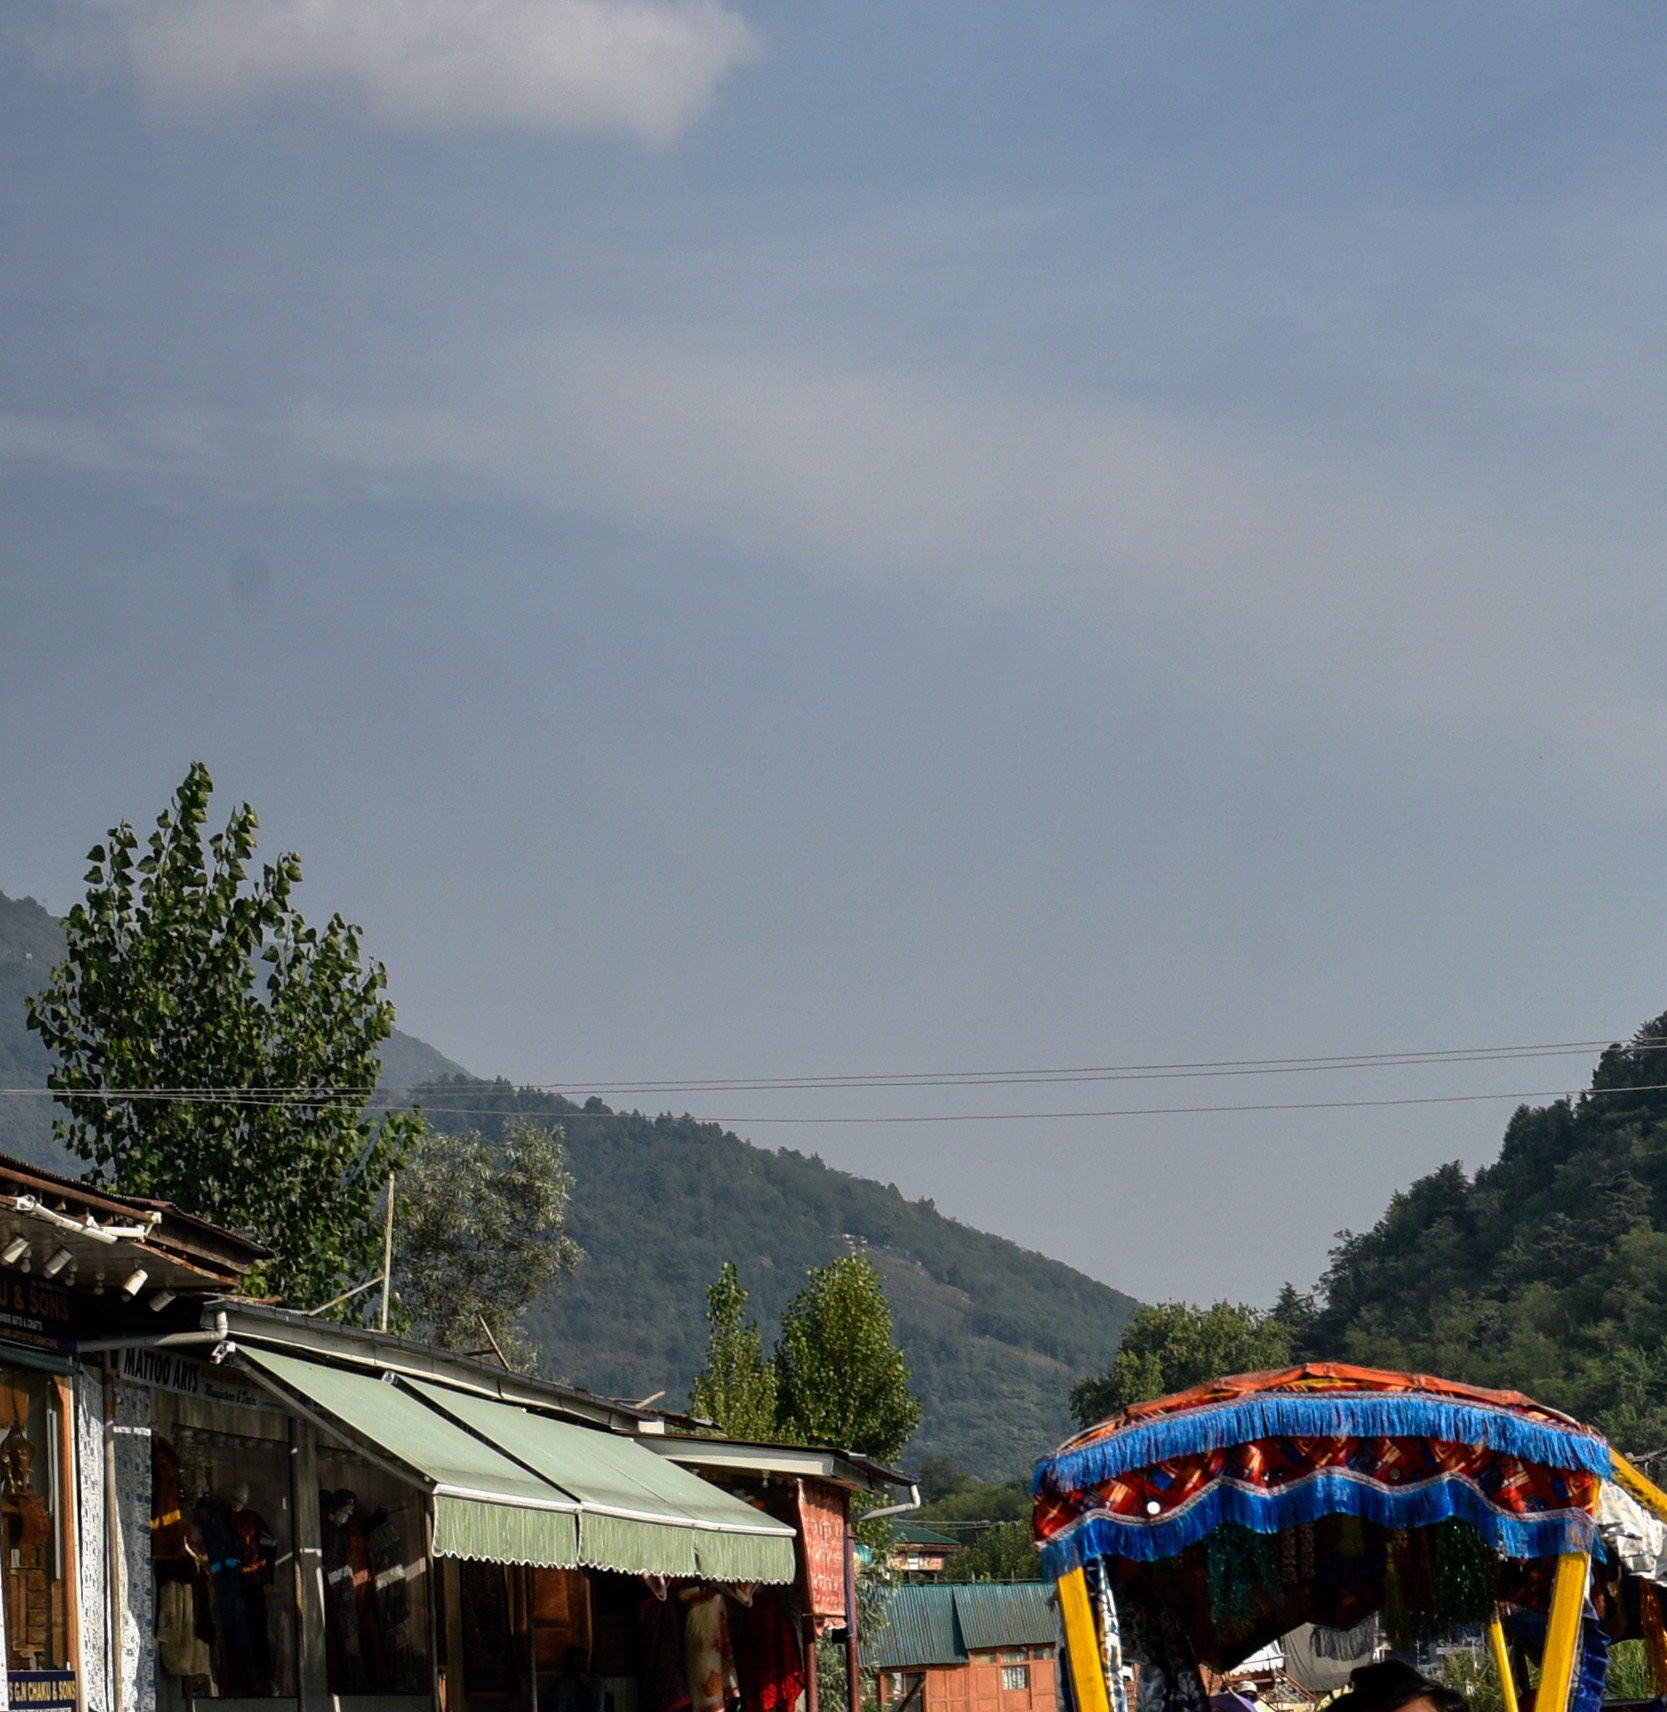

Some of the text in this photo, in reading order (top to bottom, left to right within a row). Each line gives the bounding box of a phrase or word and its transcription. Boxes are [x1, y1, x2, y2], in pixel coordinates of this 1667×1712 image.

[14, 1284, 25, 1310] &
[29, 1288, 70, 1321] SONS
[172, 1362, 199, 1394] ARTS
[28, 1681, 51, 1701] CHAKU
[59, 1681, 76, 1700] SONS
